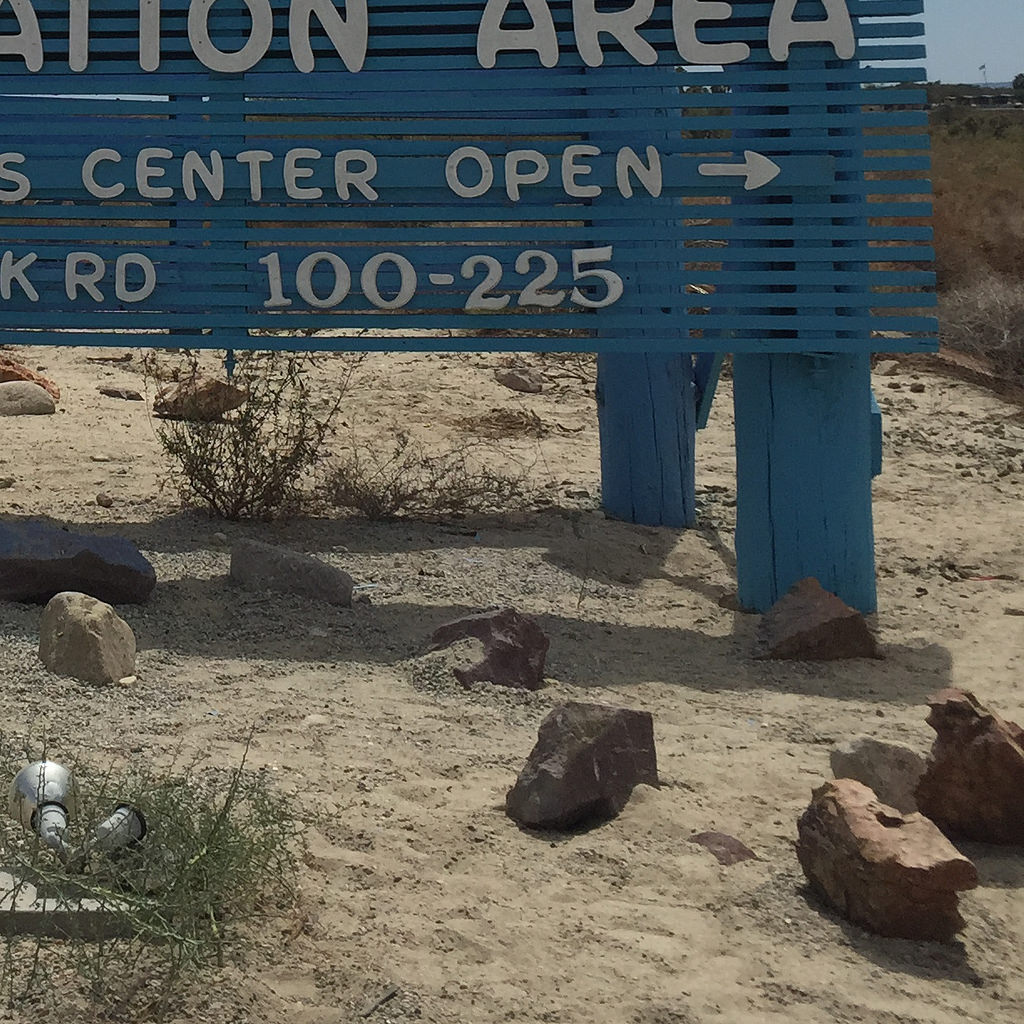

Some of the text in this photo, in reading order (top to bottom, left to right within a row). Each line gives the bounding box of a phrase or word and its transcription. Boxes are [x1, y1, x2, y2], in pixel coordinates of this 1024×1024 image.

[82, 148, 378, 201] CENTER
[445, 145, 663, 202] OPEN
[65, 251, 157, 303] RD
[257, 246, 624, 311] 100-225
